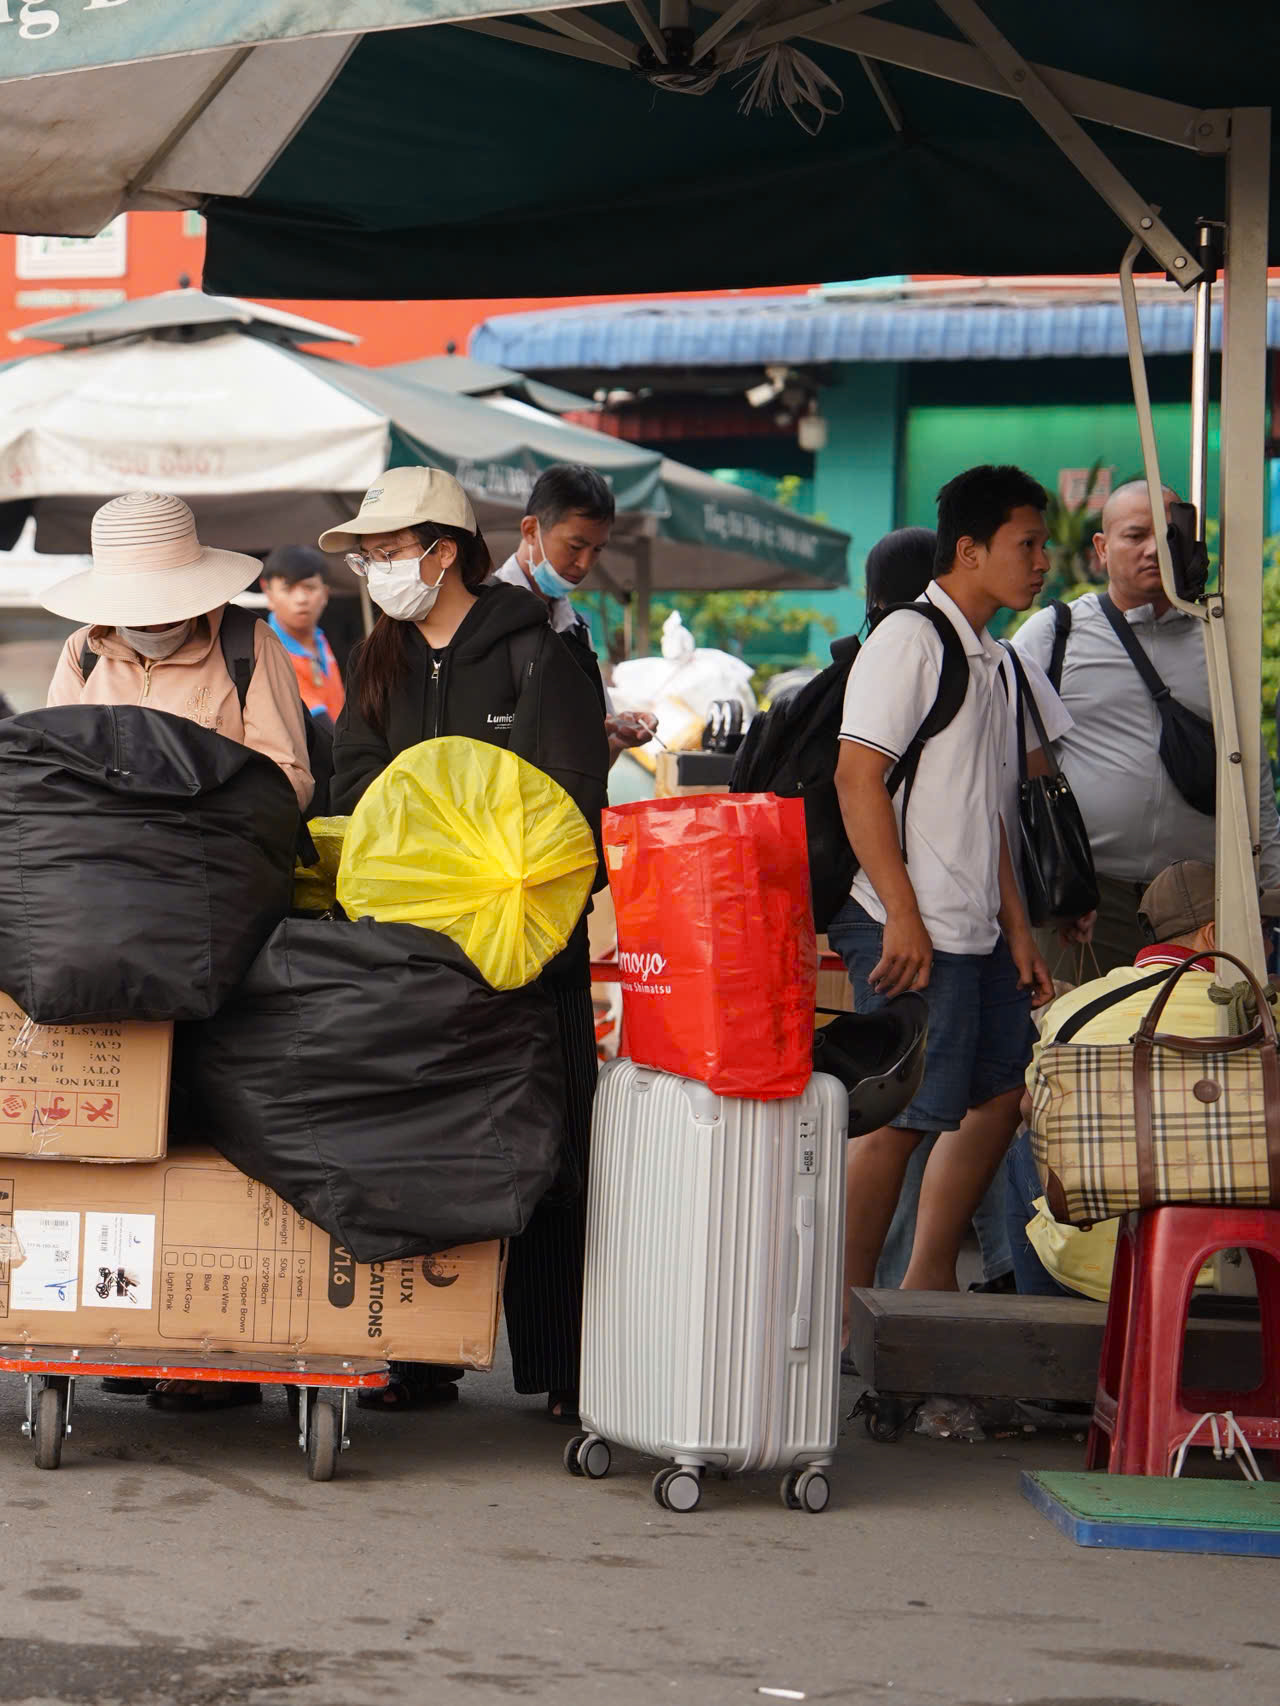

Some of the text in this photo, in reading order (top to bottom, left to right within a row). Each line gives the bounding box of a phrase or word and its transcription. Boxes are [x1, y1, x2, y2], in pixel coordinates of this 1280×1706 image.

[52, 1039, 65, 1047] 18
[89, 1040, 121, 1050] G.W:
[7, 1050, 28, 1059] KG
[89, 1053, 121, 1063] N.W:
[51, 1065, 64, 1073] 10
[17, 1076, 38, 1084] KT
[55, 1077, 79, 1085] NO:
[83, 1078, 120, 1088] ITEM
[247, 1177, 255, 1198] Color
[263, 1186, 271, 1208] cking
[280, 1217, 288, 1245] weight
[278, 1257, 287, 1278] 50kg
[333, 1246, 352, 1285] V1.6
[204, 1273, 212, 1292] Blue
[295, 1258, 305, 1298] 0-3 years
[166, 1272, 175, 1311] Light Pink
[183, 1272, 194, 1313] Dark Gray
[221, 1274, 230, 1314] Red Wine
[368, 1262, 384, 1338] CATIONS
[239, 1275, 249, 1334] Copper Brown
